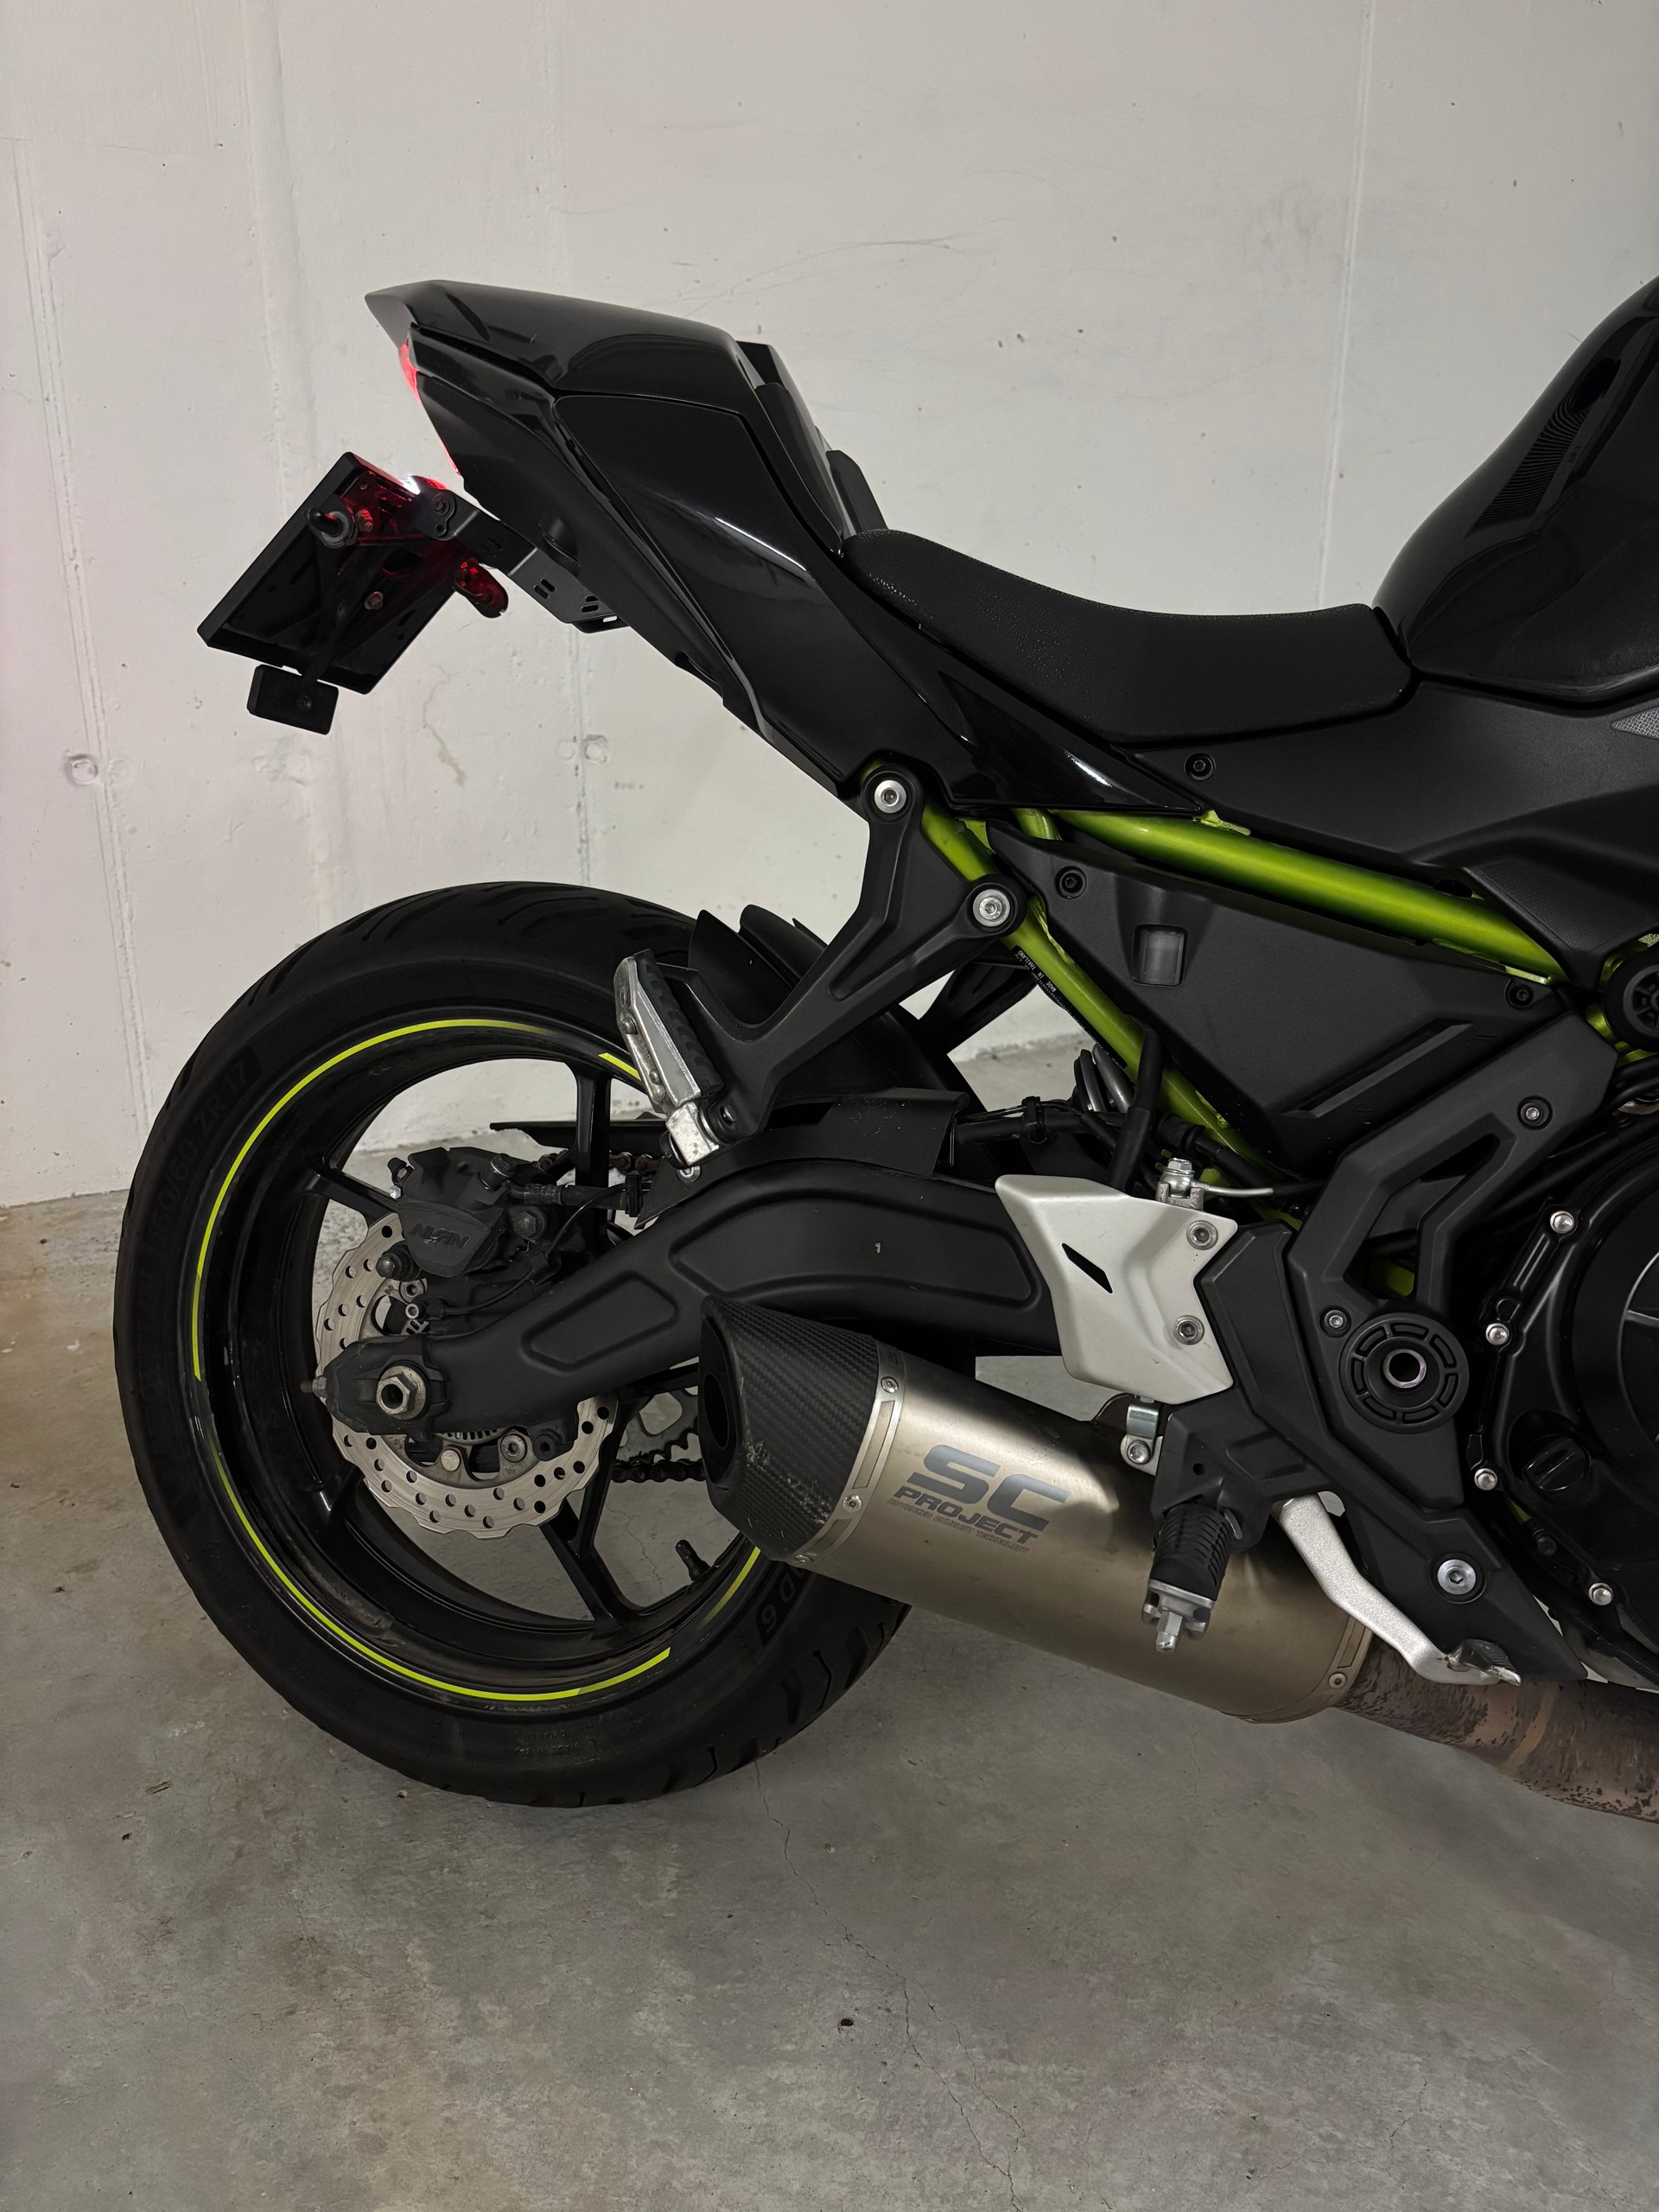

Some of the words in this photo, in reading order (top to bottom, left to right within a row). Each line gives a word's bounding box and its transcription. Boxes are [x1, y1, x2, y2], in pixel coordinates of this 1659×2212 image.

[1017, 950, 1036, 970] THAILAND
[1045, 981, 1058, 993] MADE
[193, 1094, 226, 1138] ZR
[222, 1058, 247, 1096] 17
[893, 1485, 1039, 1544] PROJECT
[906, 1444, 1071, 1532] SC
